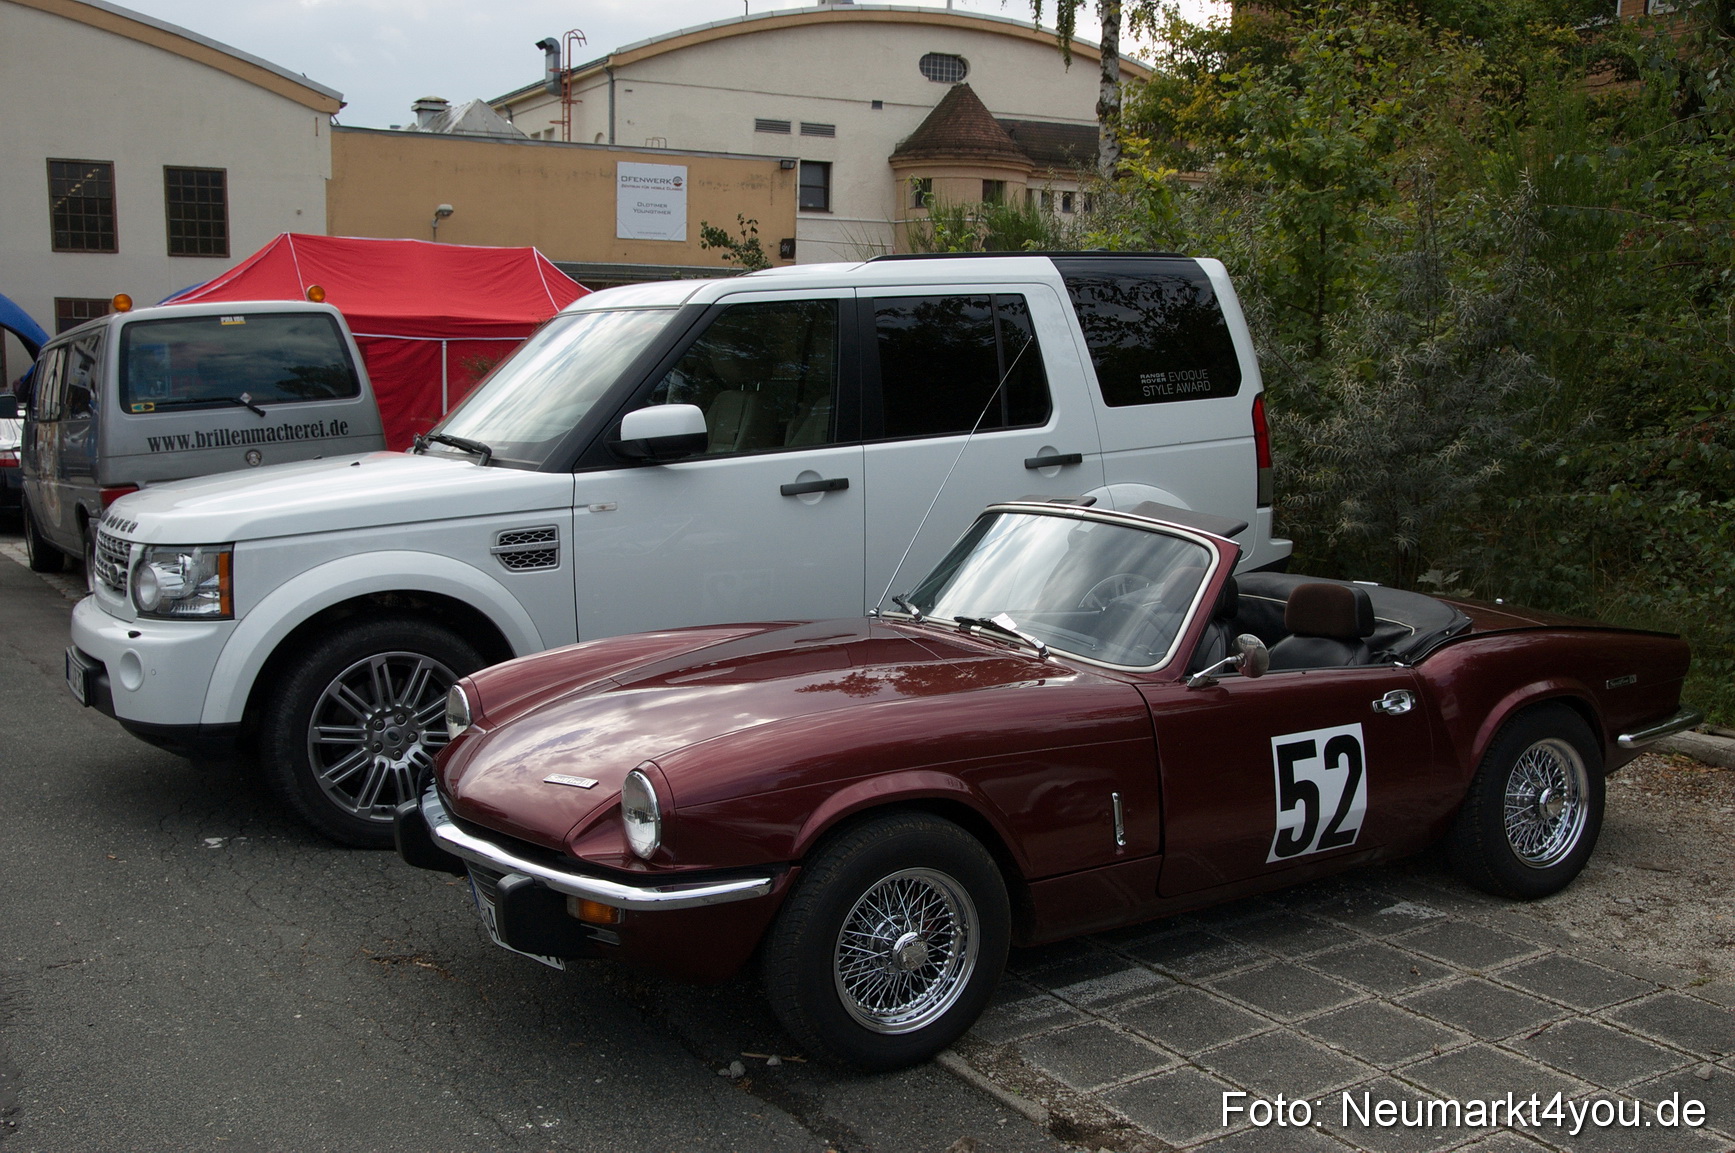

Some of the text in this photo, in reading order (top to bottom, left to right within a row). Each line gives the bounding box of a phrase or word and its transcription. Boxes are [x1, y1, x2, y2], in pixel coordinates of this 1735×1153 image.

[1168, 369, 1209, 382] EVOQUE
[1142, 380, 1211, 397] STYLE AWARD
[147, 419, 349, 452] www.brillenmacherei.de
[1274, 734, 1362, 858] 52
